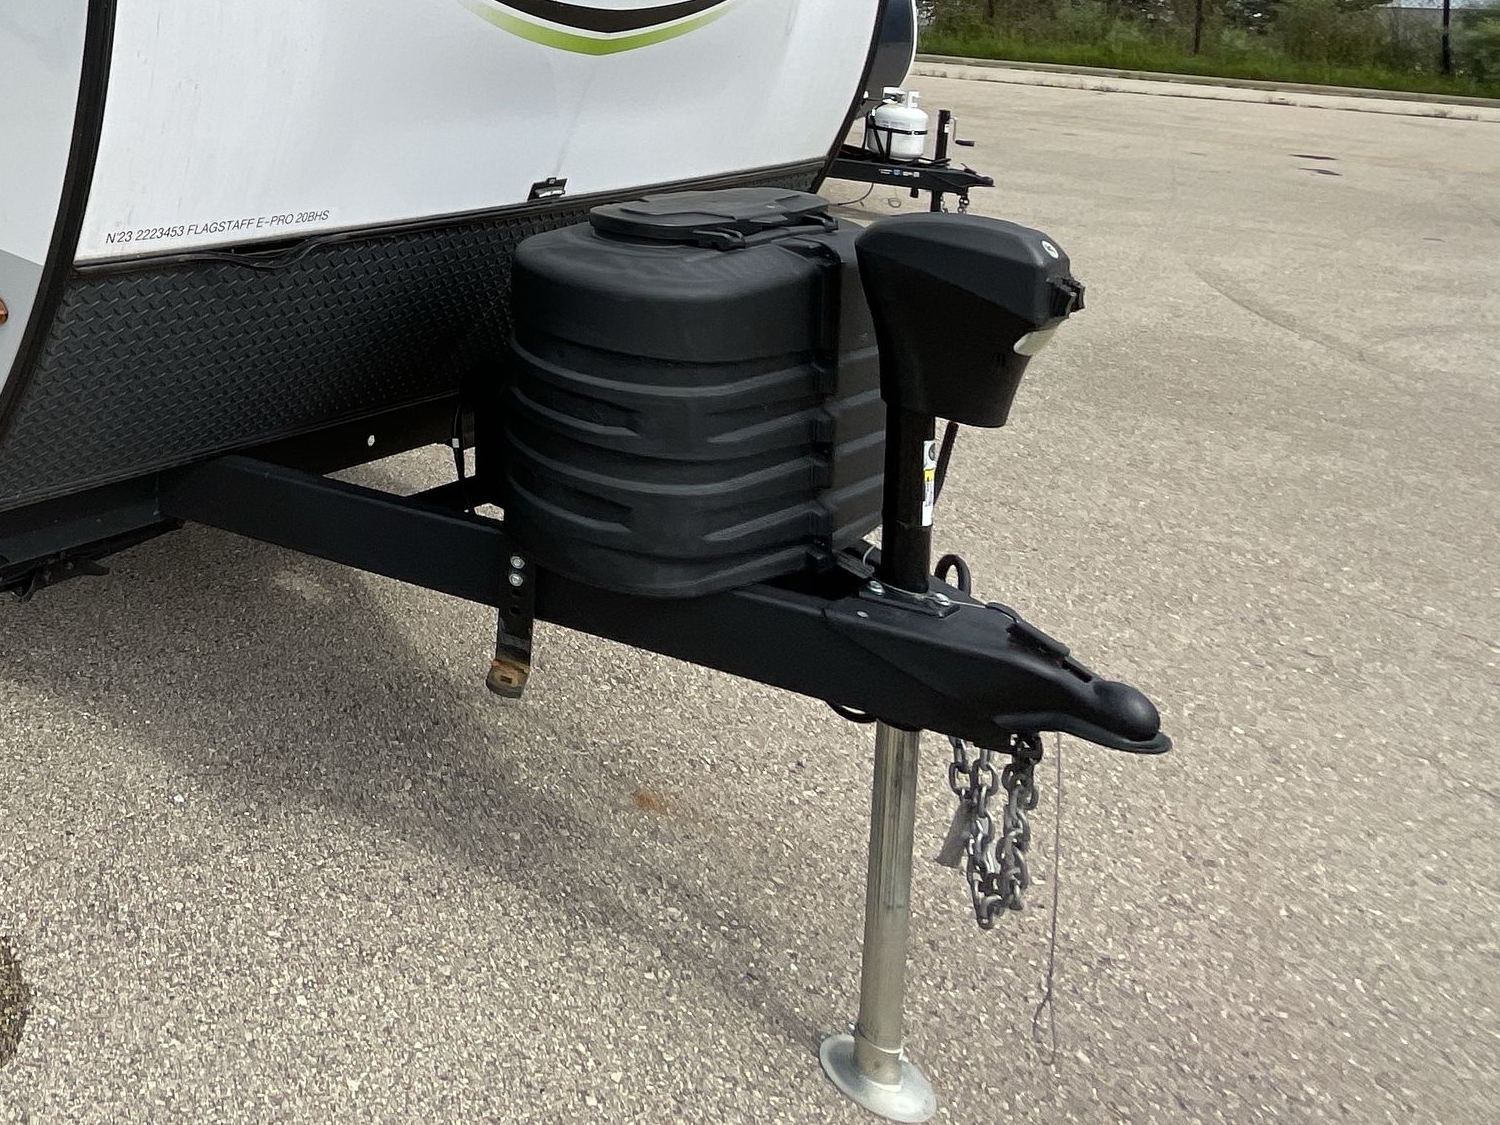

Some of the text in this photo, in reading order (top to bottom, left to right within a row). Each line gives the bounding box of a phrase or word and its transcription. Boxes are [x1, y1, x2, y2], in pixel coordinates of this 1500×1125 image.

[135, 225, 184, 241] 2223453
[187, 218, 255, 236] FLAGSTAFF
[256, 213, 294, 228] E-PRO
[295, 209, 330, 224] 20BHS
